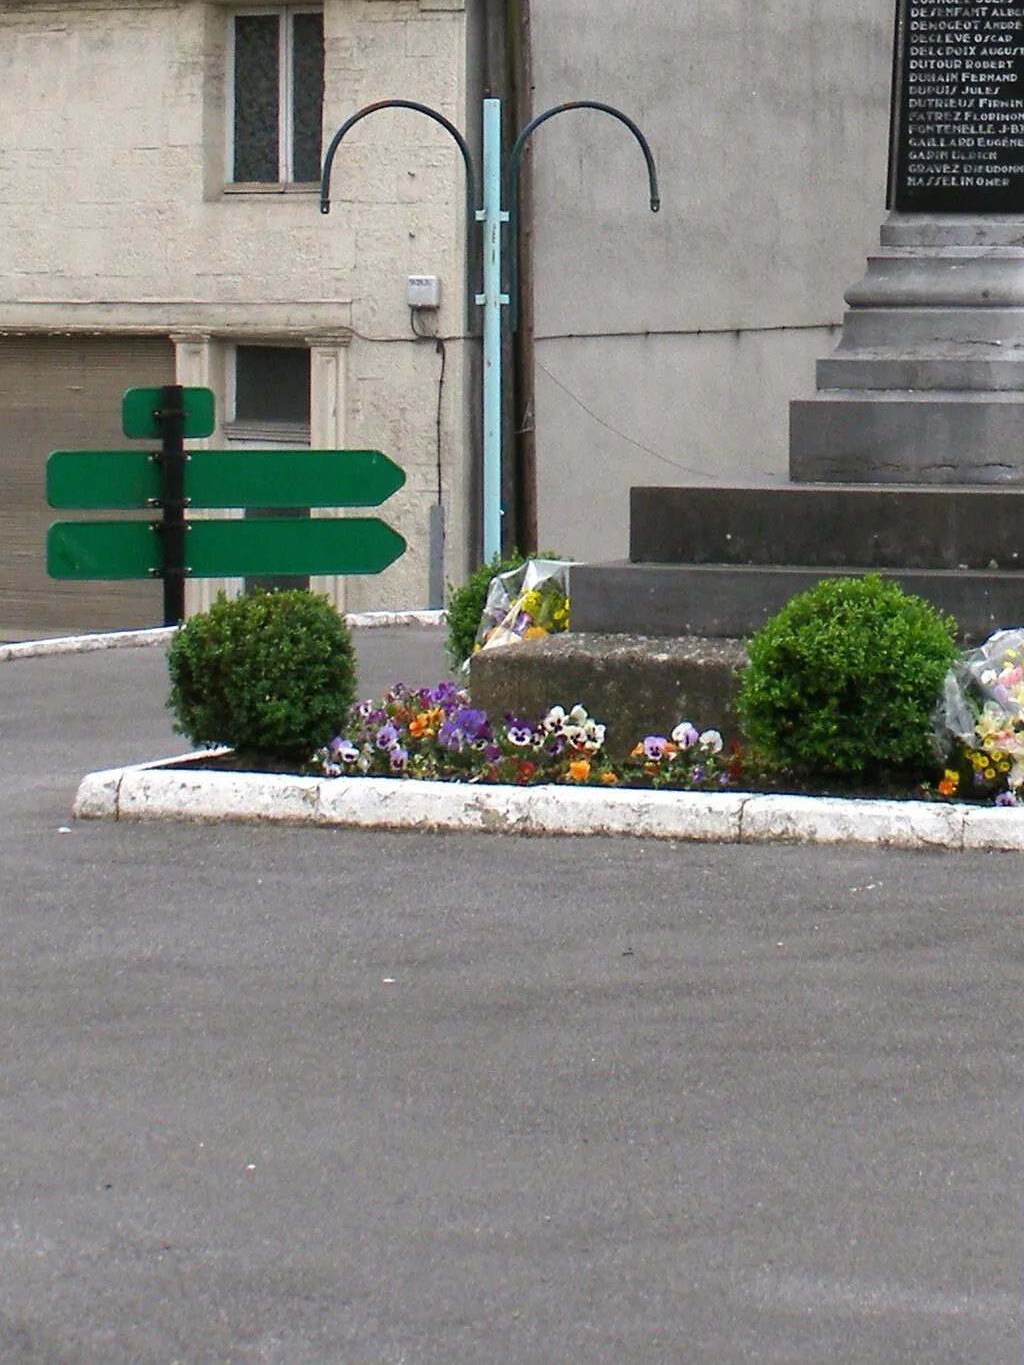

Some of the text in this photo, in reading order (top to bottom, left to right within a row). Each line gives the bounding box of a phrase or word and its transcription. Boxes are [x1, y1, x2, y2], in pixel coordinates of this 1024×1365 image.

[974, 34, 1013, 43] OSCAR
[910, 46, 976, 55] DELCROIX
[910, 60, 1013, 69] DUTOUR ROBERT
[962, 73, 1017, 82] FERNAND
[909, 86, 1000, 95] DUPUIS JULES
[909, 99, 1023, 108] DUTRIEUX FIRMIN
[909, 137, 974, 147] GAILLARD
[909, 164, 959, 173] GRAVEZ
[976, 177, 1009, 186] OMER
